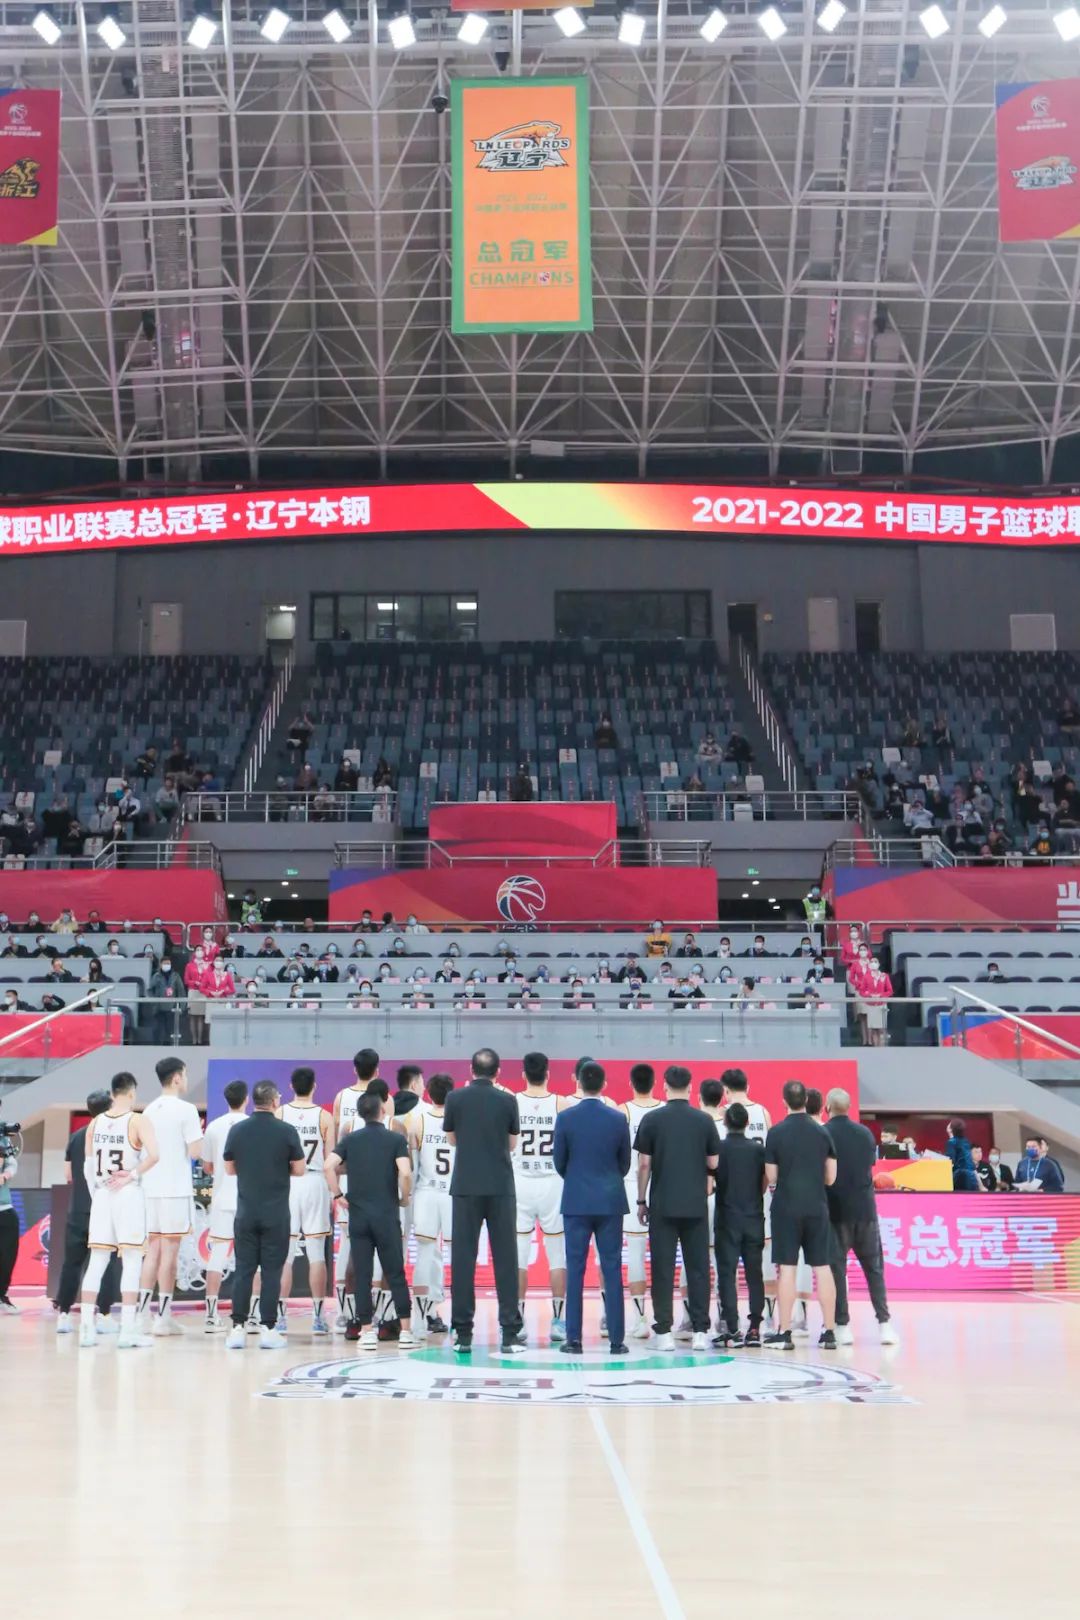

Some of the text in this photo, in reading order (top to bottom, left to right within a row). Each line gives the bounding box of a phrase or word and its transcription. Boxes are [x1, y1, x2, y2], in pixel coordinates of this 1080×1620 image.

[478, 140, 493, 150] LN
[499, 150, 547, 168] 辽宁
[477, 238, 569, 262] 总冠军
[469, 271, 574, 287] CHAMPIONS
[692, 496, 863, 529] 2021-2022
[521, 1130, 555, 1156] 22
[96, 1149, 124, 1177] 13
[436, 1148, 450, 1175] 5
[260, 1390, 618, 1401] CHINA
